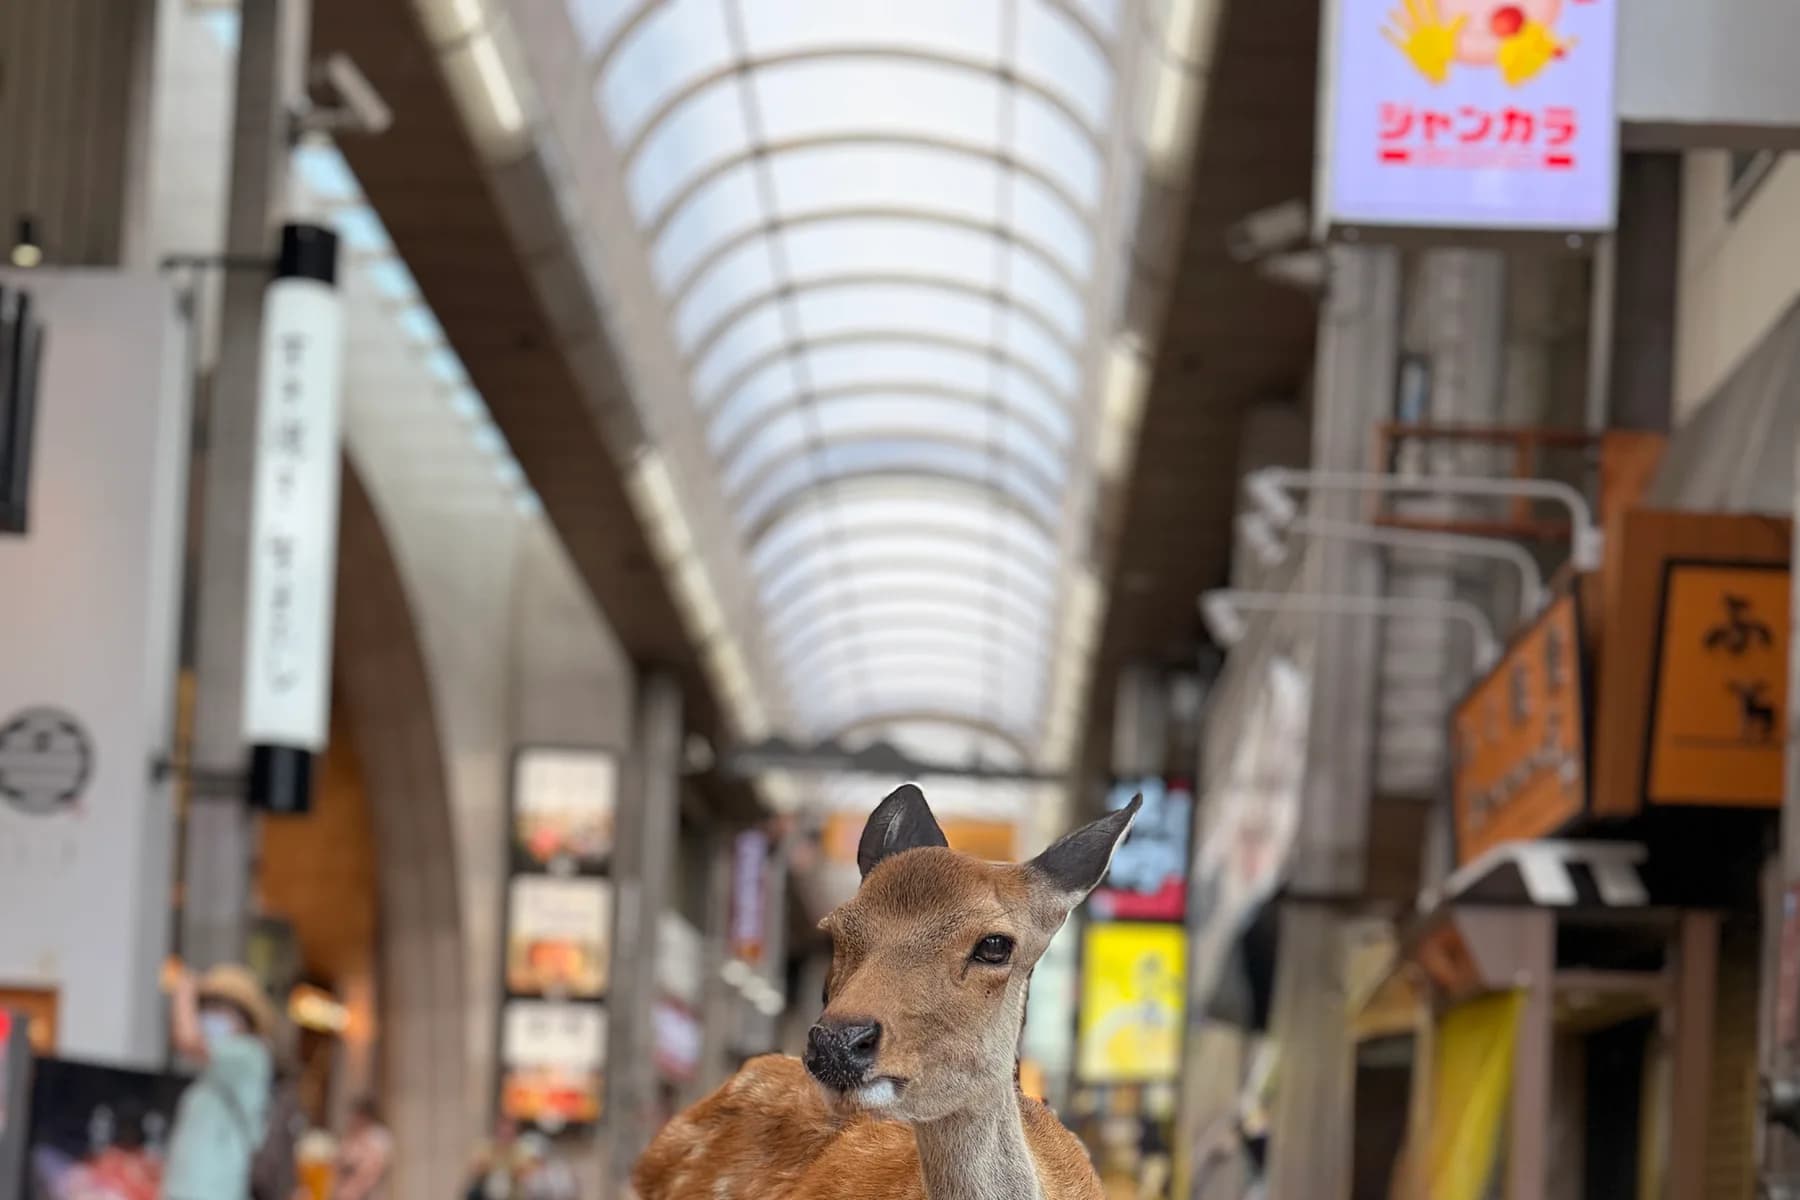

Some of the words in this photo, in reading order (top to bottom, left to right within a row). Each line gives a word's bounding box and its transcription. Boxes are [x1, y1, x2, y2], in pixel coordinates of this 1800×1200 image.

[1379, 102, 1577, 146] ジャンカラ
